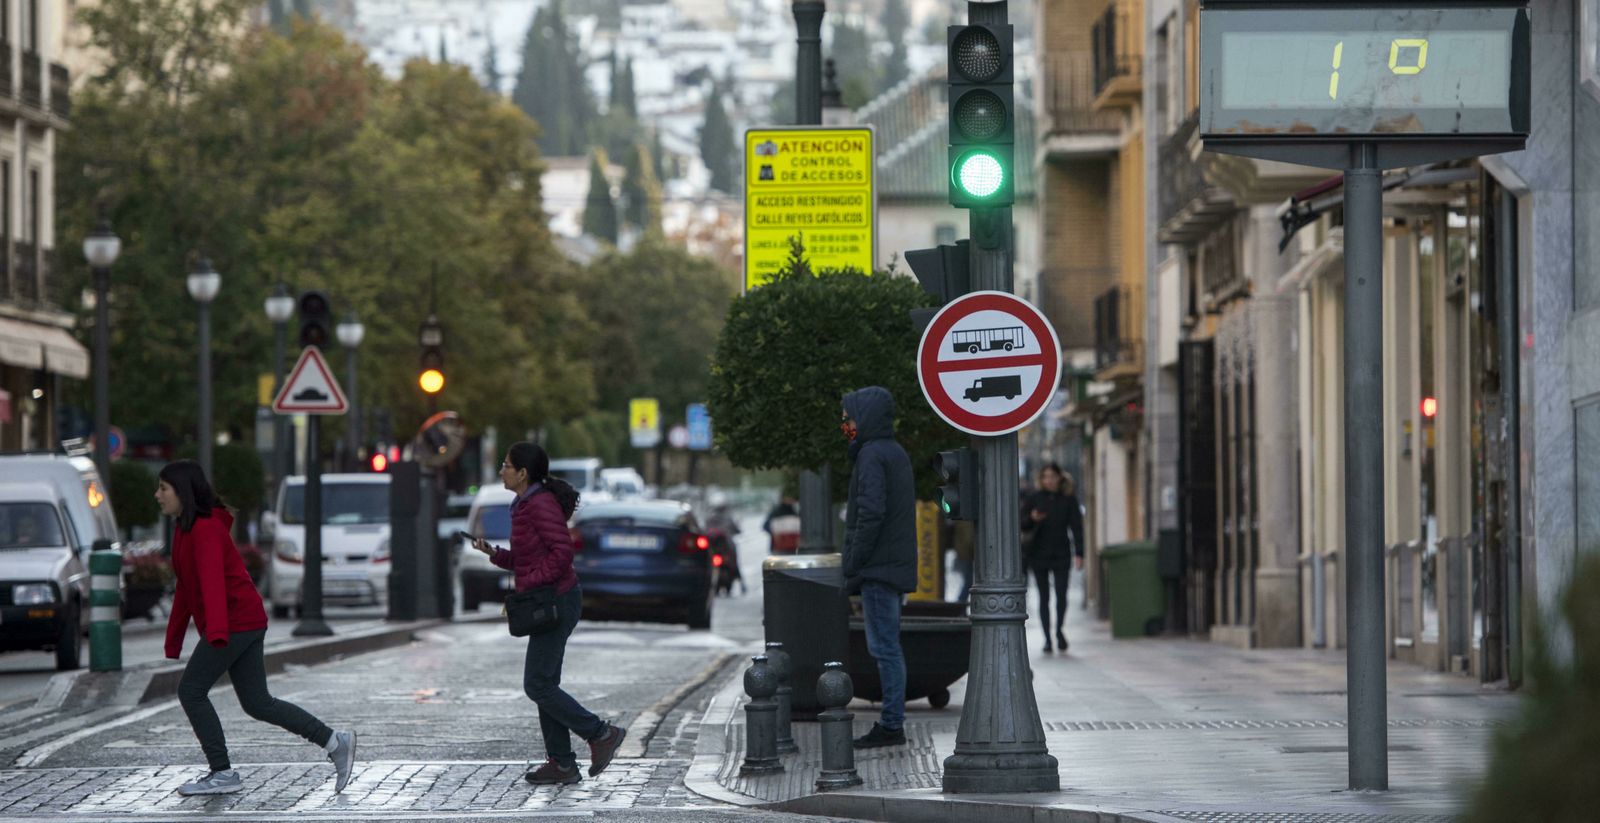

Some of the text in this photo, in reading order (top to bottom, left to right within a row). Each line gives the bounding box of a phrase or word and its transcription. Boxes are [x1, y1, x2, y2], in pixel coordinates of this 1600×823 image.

[780, 138, 863, 154] ATENCIÓN
[791, 156, 853, 168] CONTROL
[781, 170, 863, 181] DE ACCESOS
[756, 195, 863, 207] ACCESO RESTRINGIDO
[756, 212, 863, 225] CALLE REYES CATÓLICOS
